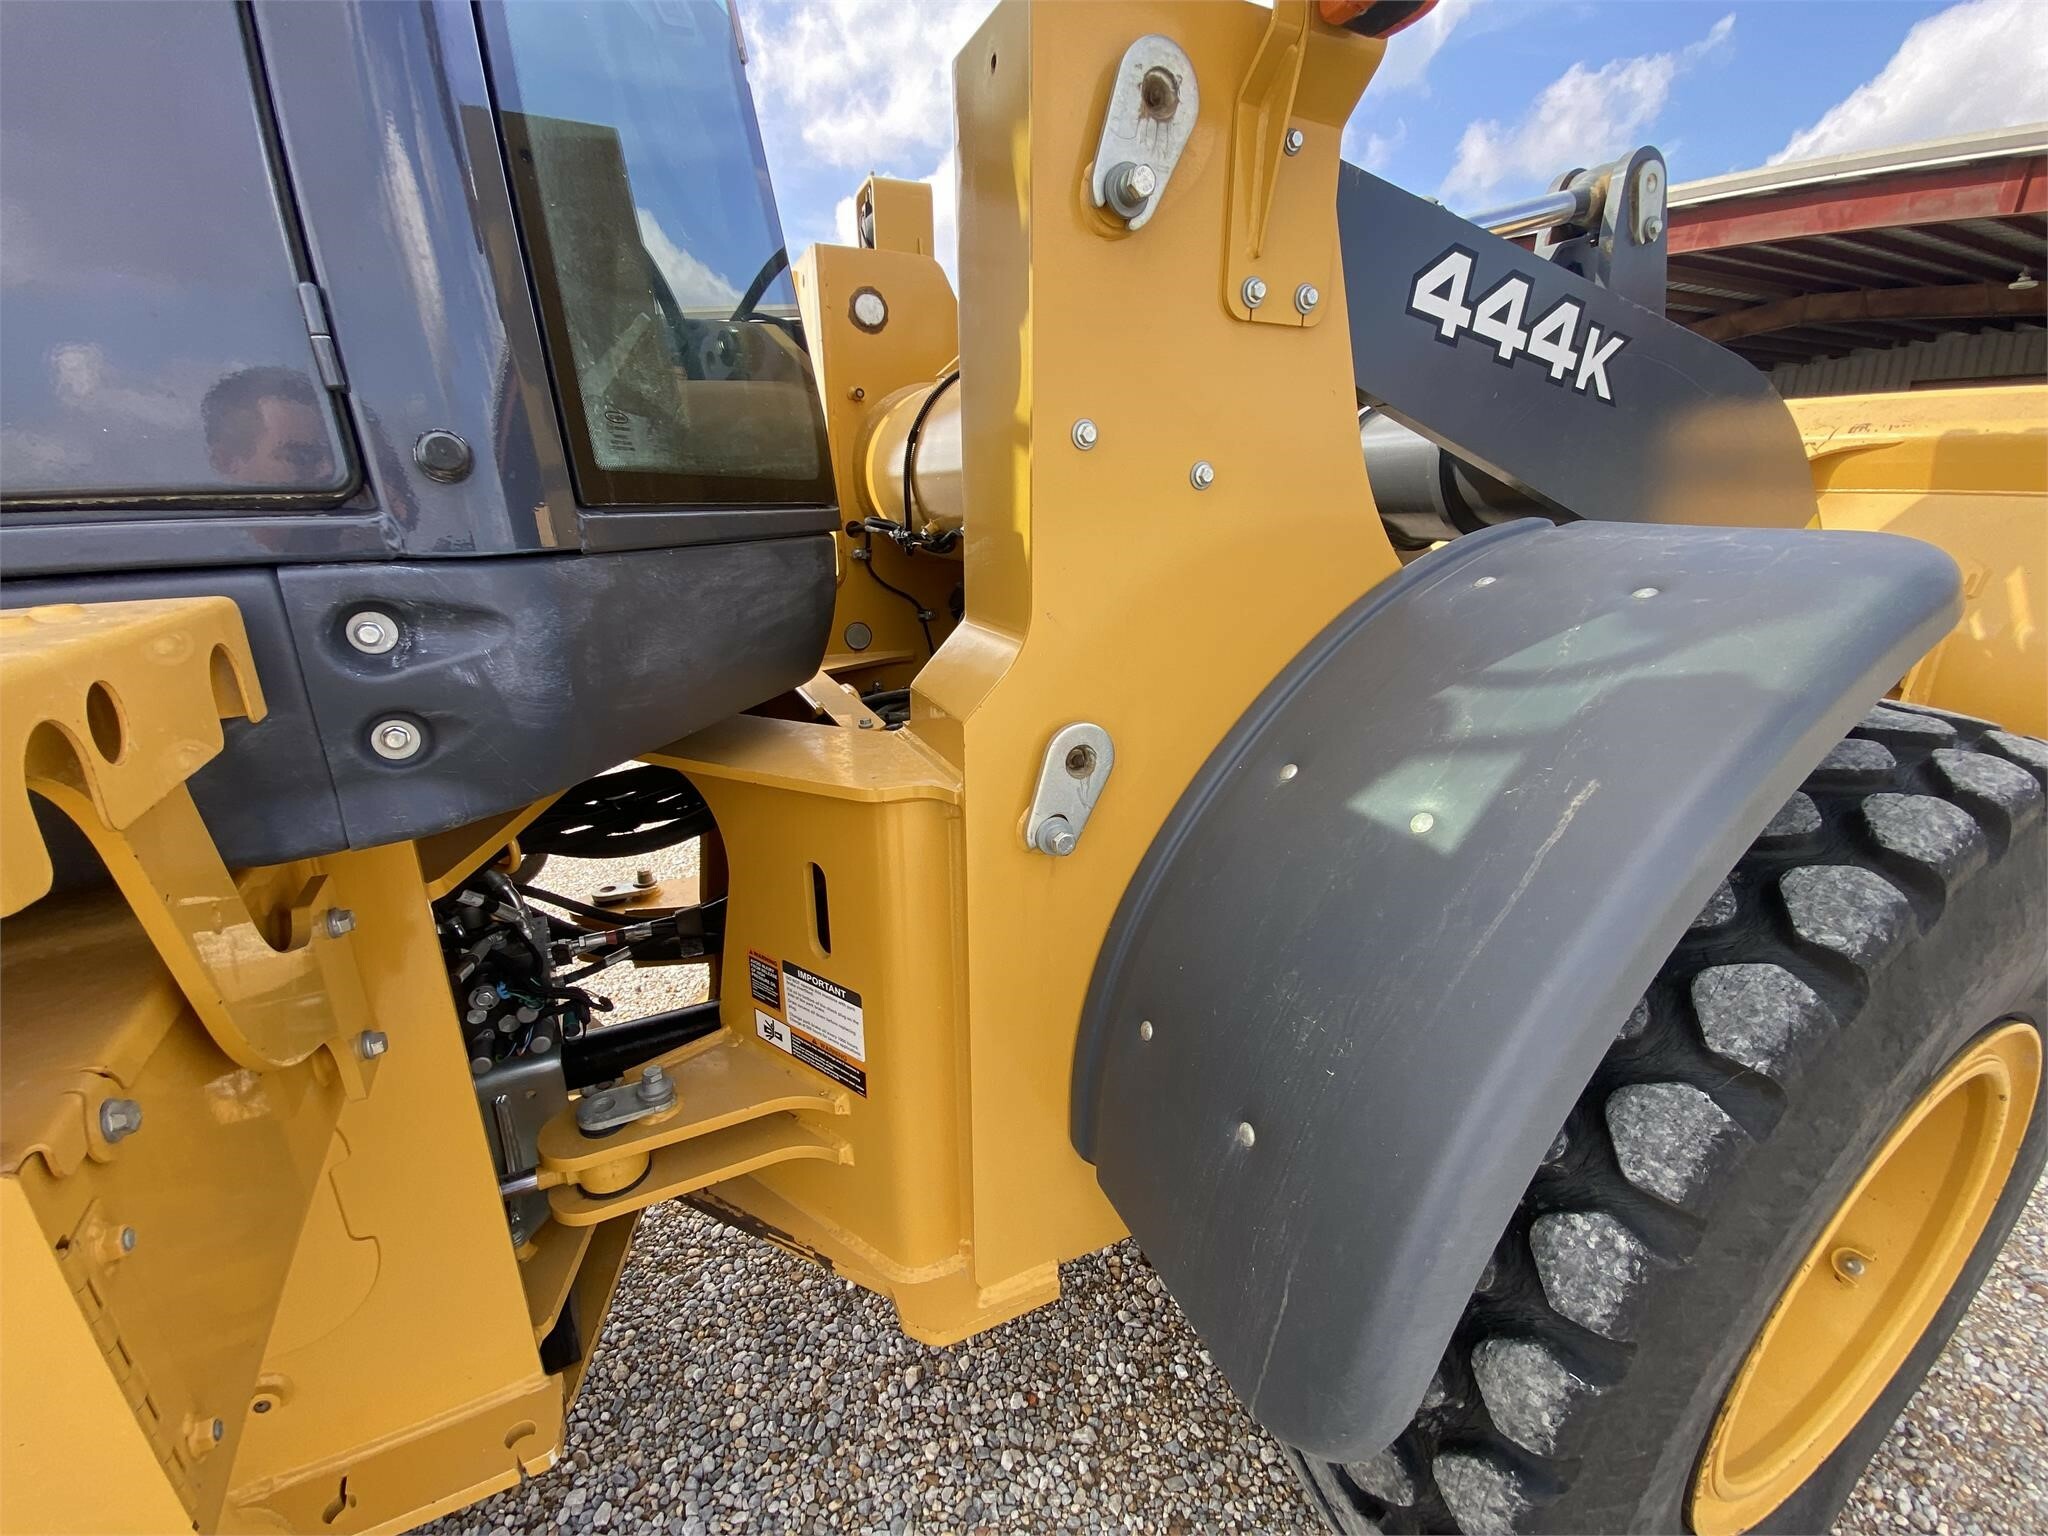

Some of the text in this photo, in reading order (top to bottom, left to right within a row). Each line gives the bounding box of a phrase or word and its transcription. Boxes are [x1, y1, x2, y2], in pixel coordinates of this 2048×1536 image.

[1411, 250, 1625, 401] 444K
[797, 970, 846, 998] IMPORTANT
[820, 1042, 848, 1061] WARNING
